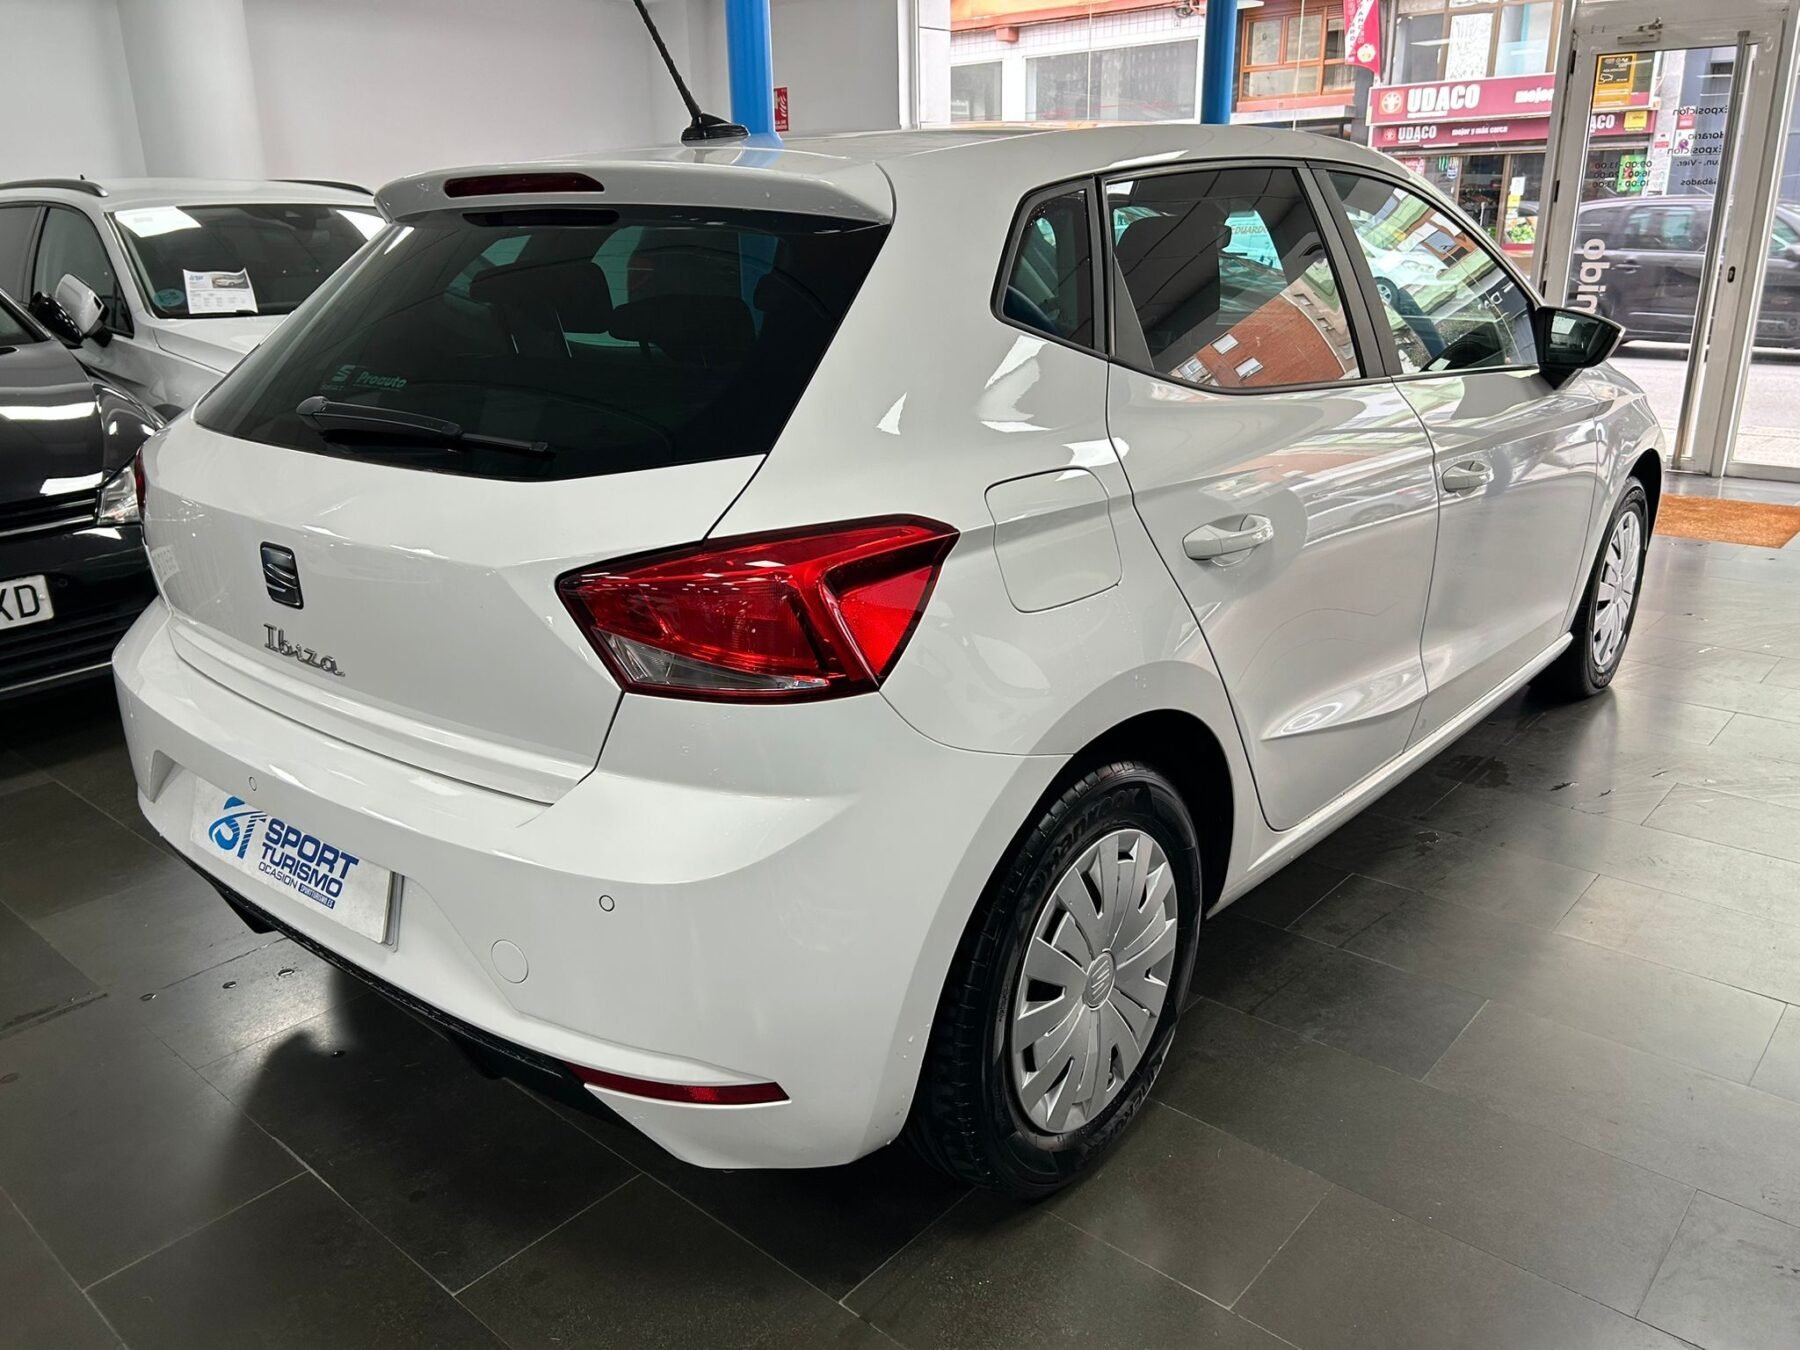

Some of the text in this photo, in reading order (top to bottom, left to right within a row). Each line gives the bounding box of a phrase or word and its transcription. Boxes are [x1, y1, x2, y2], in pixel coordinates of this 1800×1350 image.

[1407, 84, 1480, 113] UDACO
[1398, 126, 1437, 141] UDACO
[355, 371, 408, 389] Proauto
[263, 623, 346, 677] Ibiza
[265, 818, 360, 880] SPORT
[258, 861, 299, 890] OCASION
[262, 842, 343, 898] TURISMO
